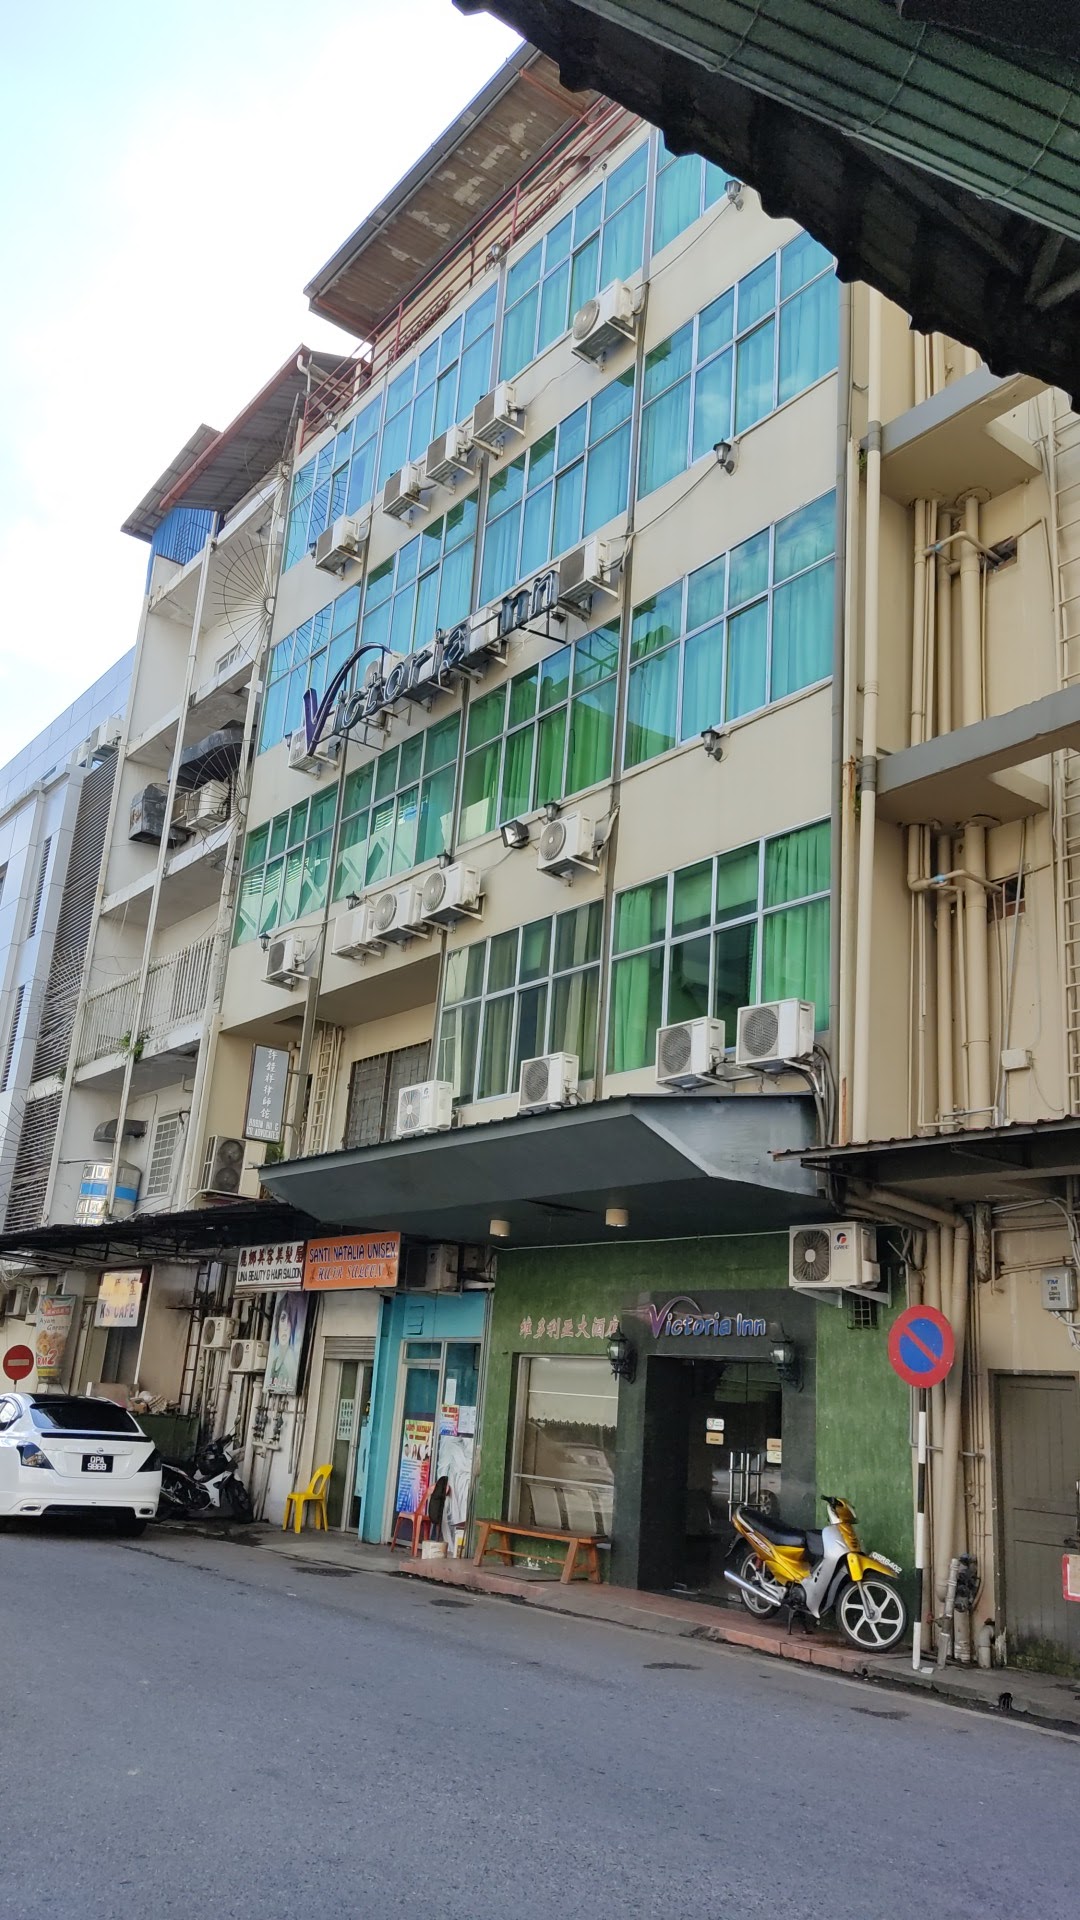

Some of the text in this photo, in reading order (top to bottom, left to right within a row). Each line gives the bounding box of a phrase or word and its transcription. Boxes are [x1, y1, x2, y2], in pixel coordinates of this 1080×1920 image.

[303, 624, 471, 757] Victoria
[309, 1247, 331, 1263] SANTI
[333, 1244, 364, 1260] NATALIA
[648, 1295, 766, 1339] Victoria Inn
